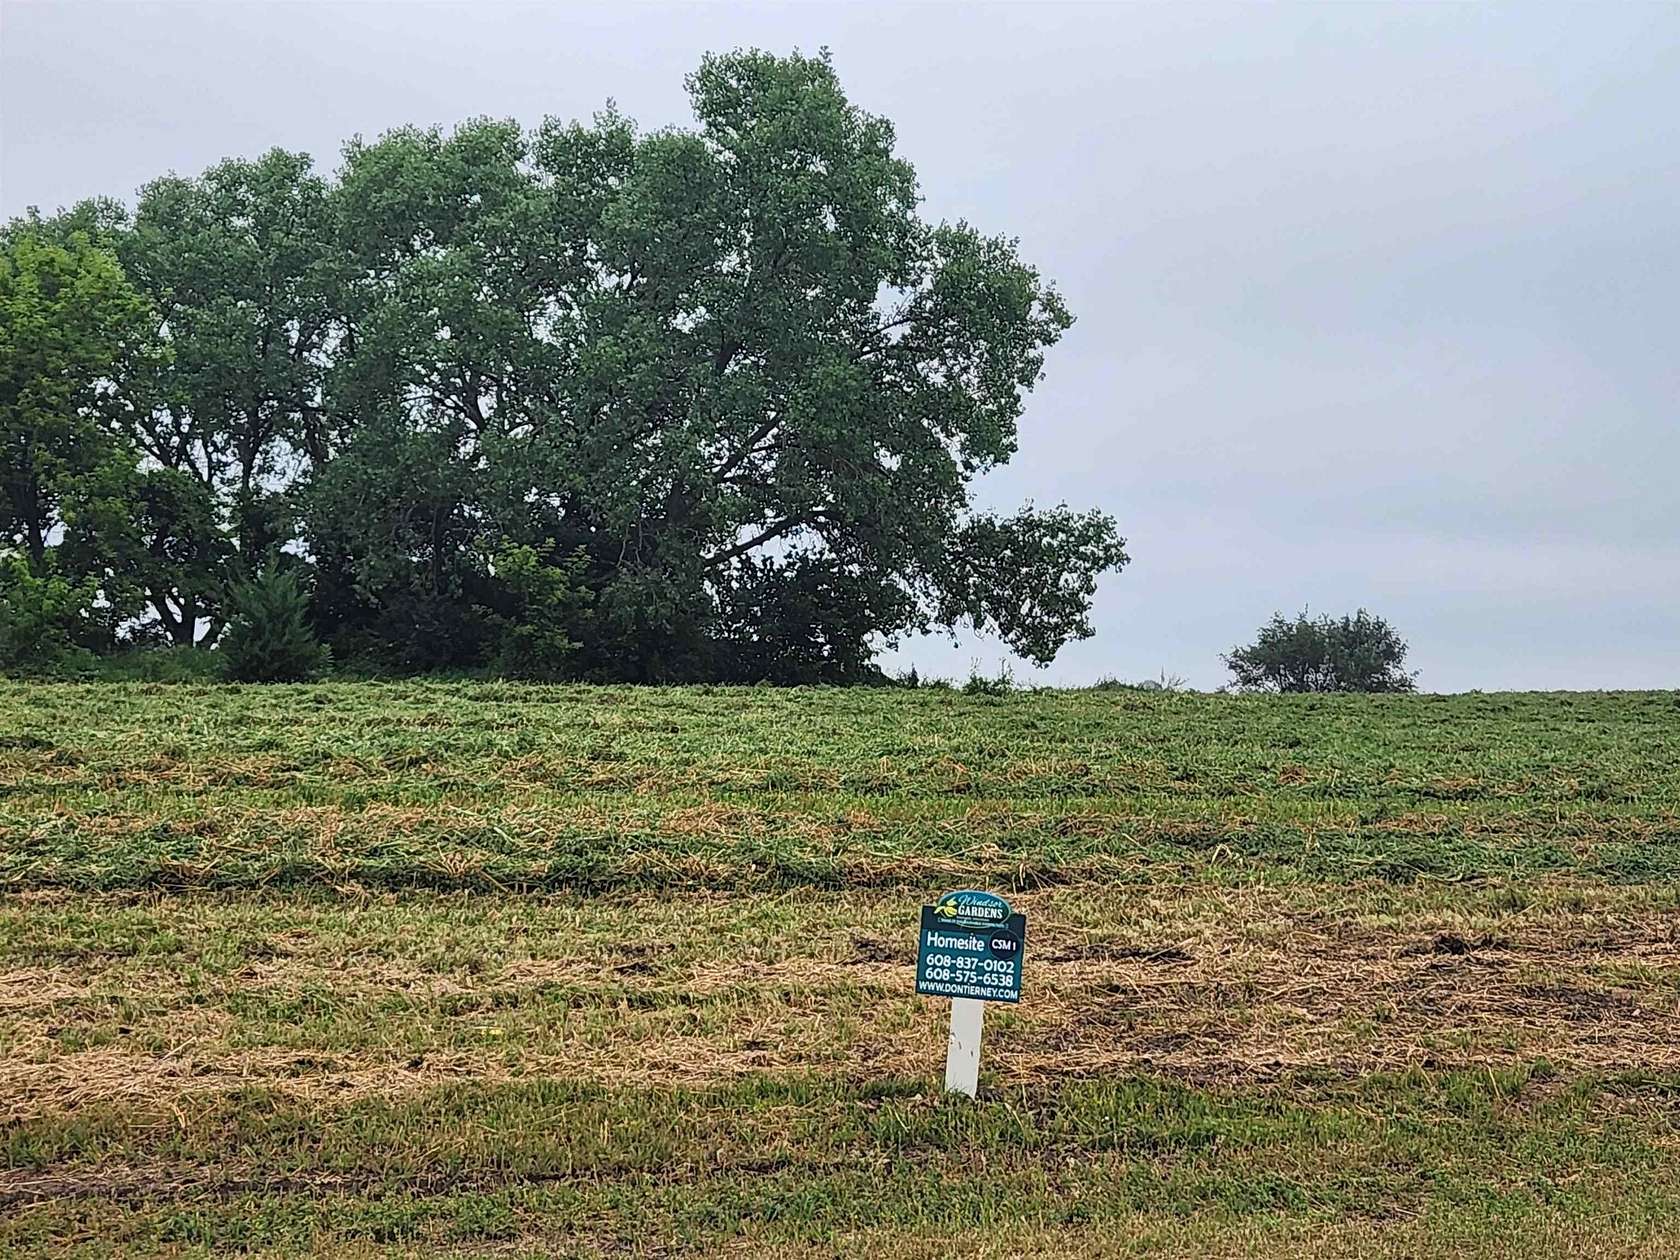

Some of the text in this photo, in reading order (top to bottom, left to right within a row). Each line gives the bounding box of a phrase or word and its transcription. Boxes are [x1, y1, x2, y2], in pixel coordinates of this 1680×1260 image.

[958, 905, 1003, 919] GARDENS
[927, 931, 985, 951] Homesite
[992, 939, 1011, 951] CSM
[926, 954, 1014, 973] 608-837-0102
[925, 967, 1014, 987] 608-575-6538
